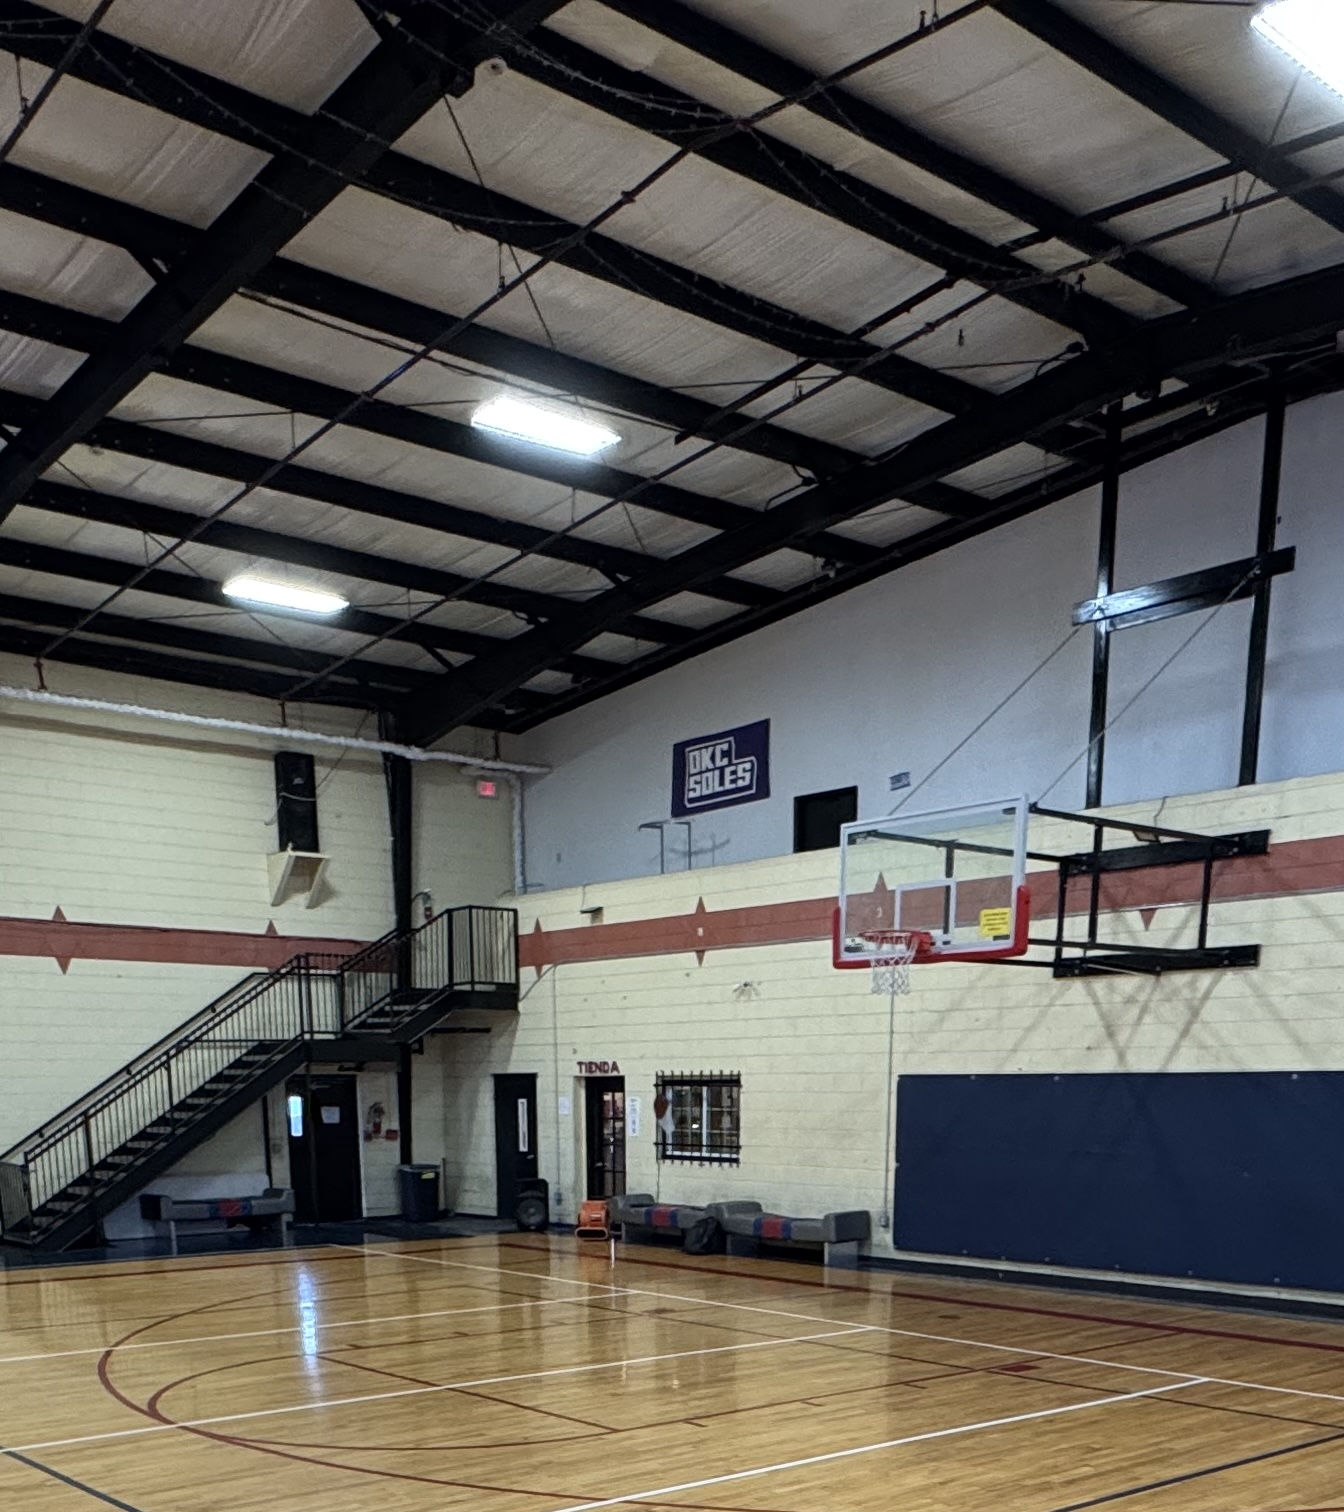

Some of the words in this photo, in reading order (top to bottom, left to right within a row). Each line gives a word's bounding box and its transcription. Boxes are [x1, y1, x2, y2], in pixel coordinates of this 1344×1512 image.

[688, 743, 730, 774] OKC
[687, 762, 752, 799] SOLES
[576, 1060, 620, 1075] TIENDA
